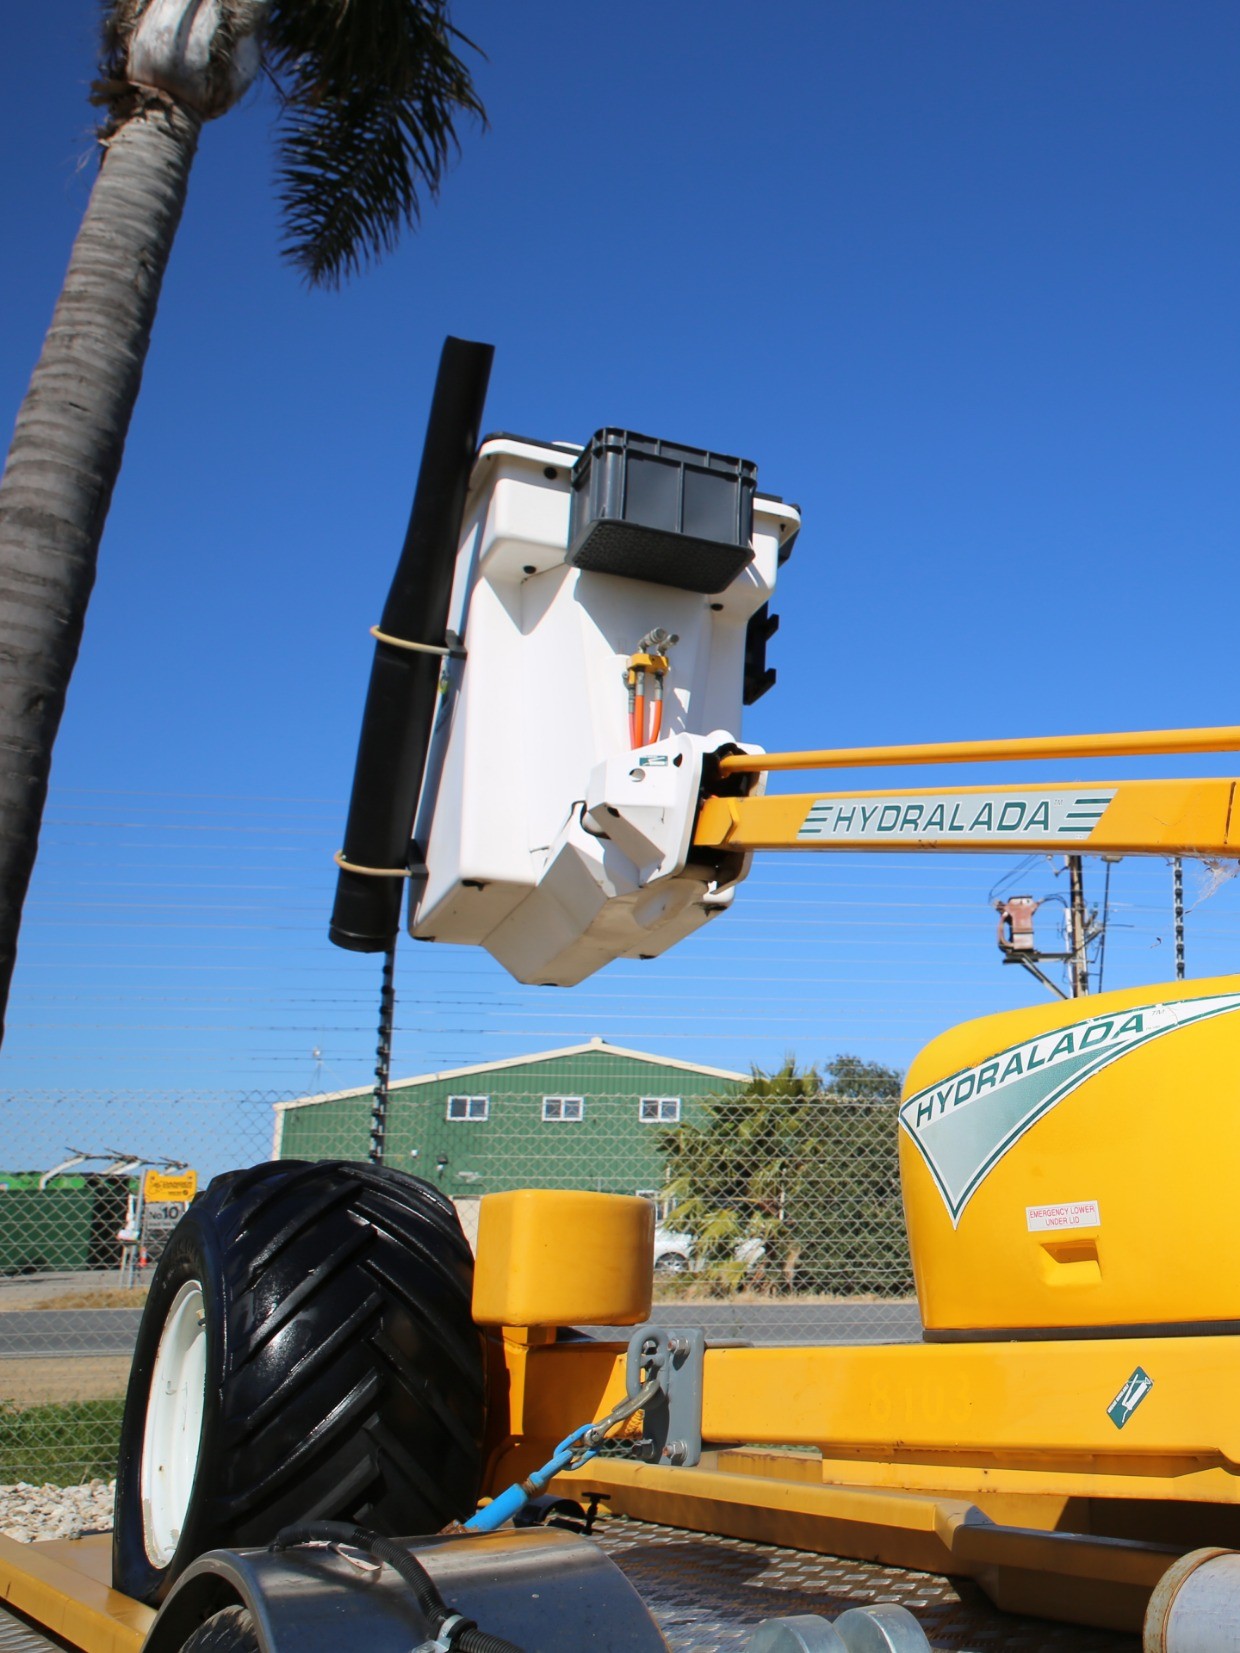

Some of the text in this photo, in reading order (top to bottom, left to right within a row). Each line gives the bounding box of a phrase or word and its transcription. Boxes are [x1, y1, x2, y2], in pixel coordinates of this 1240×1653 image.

[833, 801, 1050, 832] HYDRALADA
[916, 1014, 1144, 1128] HYDRALADA
[163, 1206, 179, 1219] 10
[1029, 1205, 1095, 1218] EMERGENCY LOWER
[1046, 1216, 1080, 1226] UNDER LID
